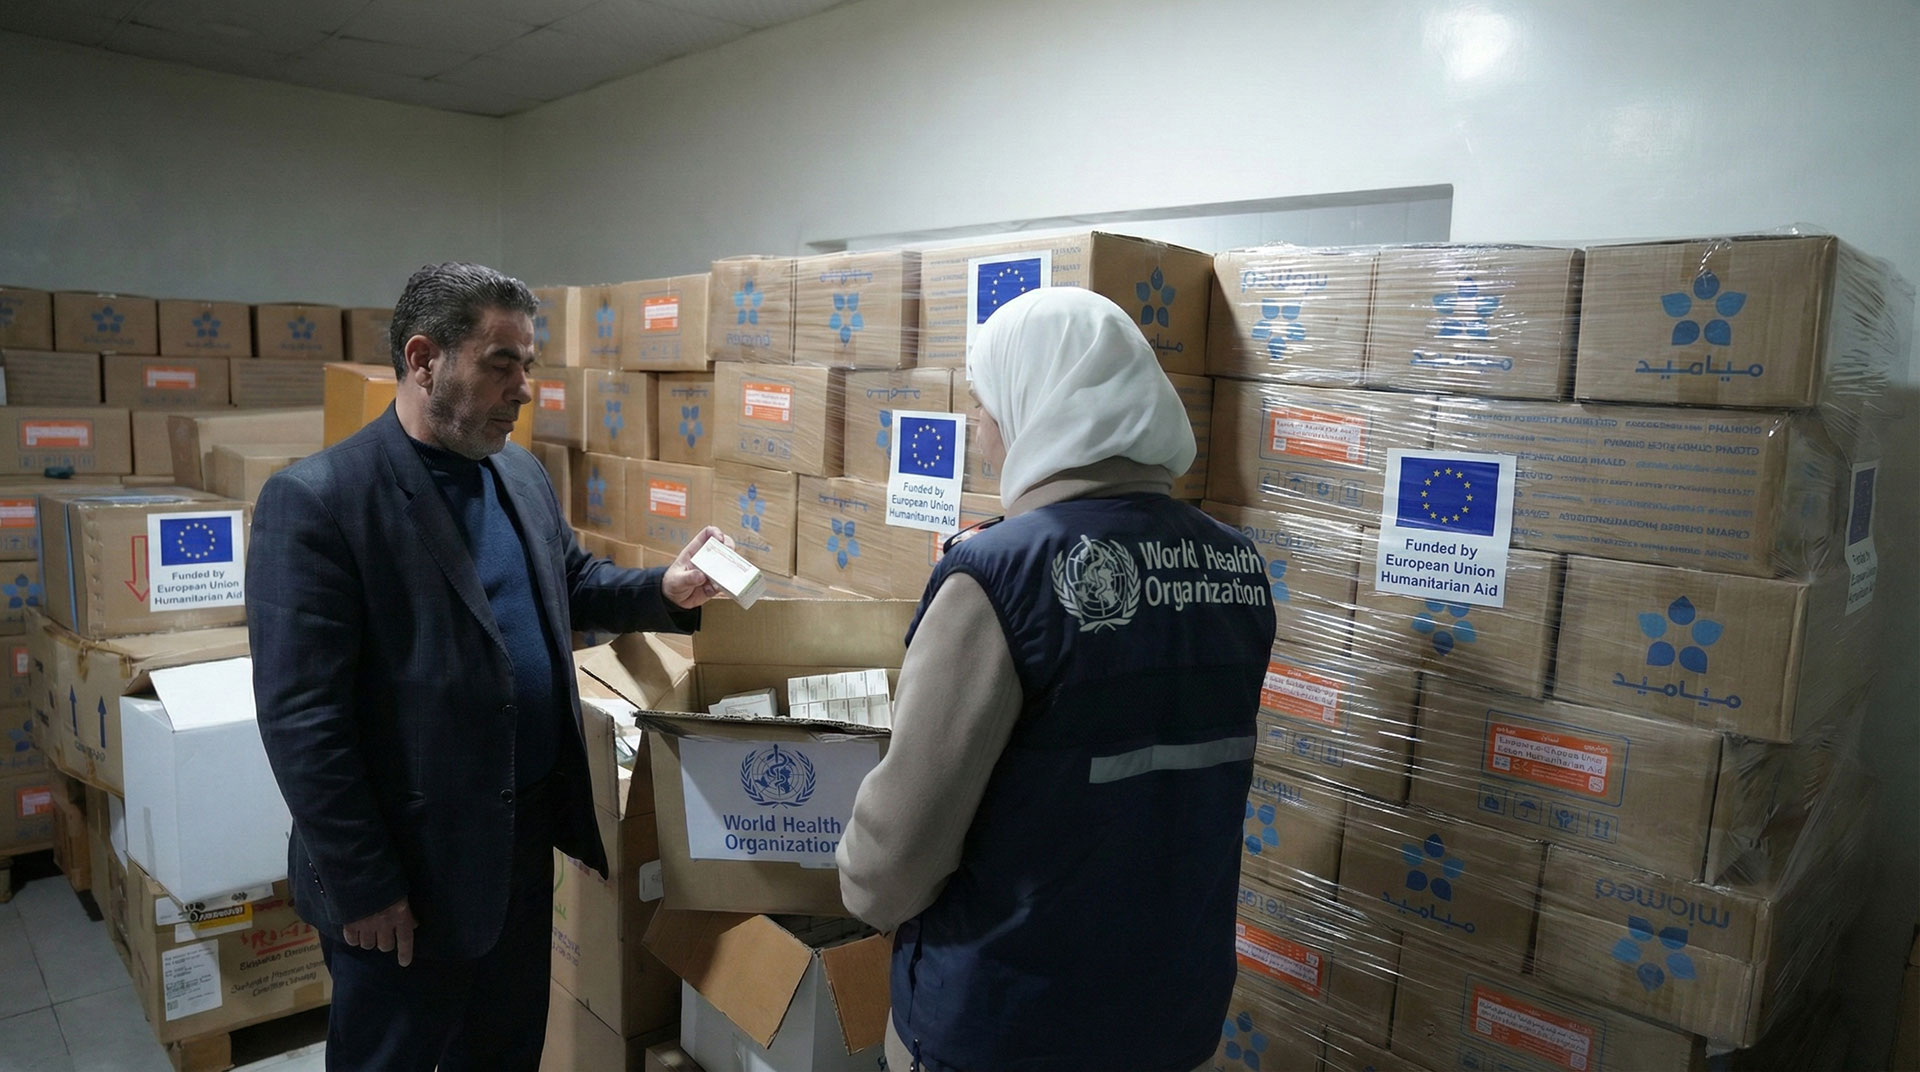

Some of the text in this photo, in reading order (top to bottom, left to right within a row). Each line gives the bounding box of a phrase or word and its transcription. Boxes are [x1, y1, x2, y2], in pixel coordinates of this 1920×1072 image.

[1635, 355, 1764, 382] مياميد
[903, 481, 945, 498] Funded by
[892, 494, 954, 512] European Union
[941, 515, 956, 527] Aid
[1138, 537, 1263, 574] World Health
[1405, 538, 1478, 560] Funded by
[172, 569, 225, 581] Funded by
[1385, 553, 1496, 578] European Union
[157, 580, 239, 594] European Union
[1145, 573, 1267, 612] Organization
[1381, 570, 1498, 597] Humanitarian Aid
[154, 590, 243, 605] Humanitarian Aid
[1612, 672, 1742, 709] مياميد
[723, 814, 841, 834] World Health
